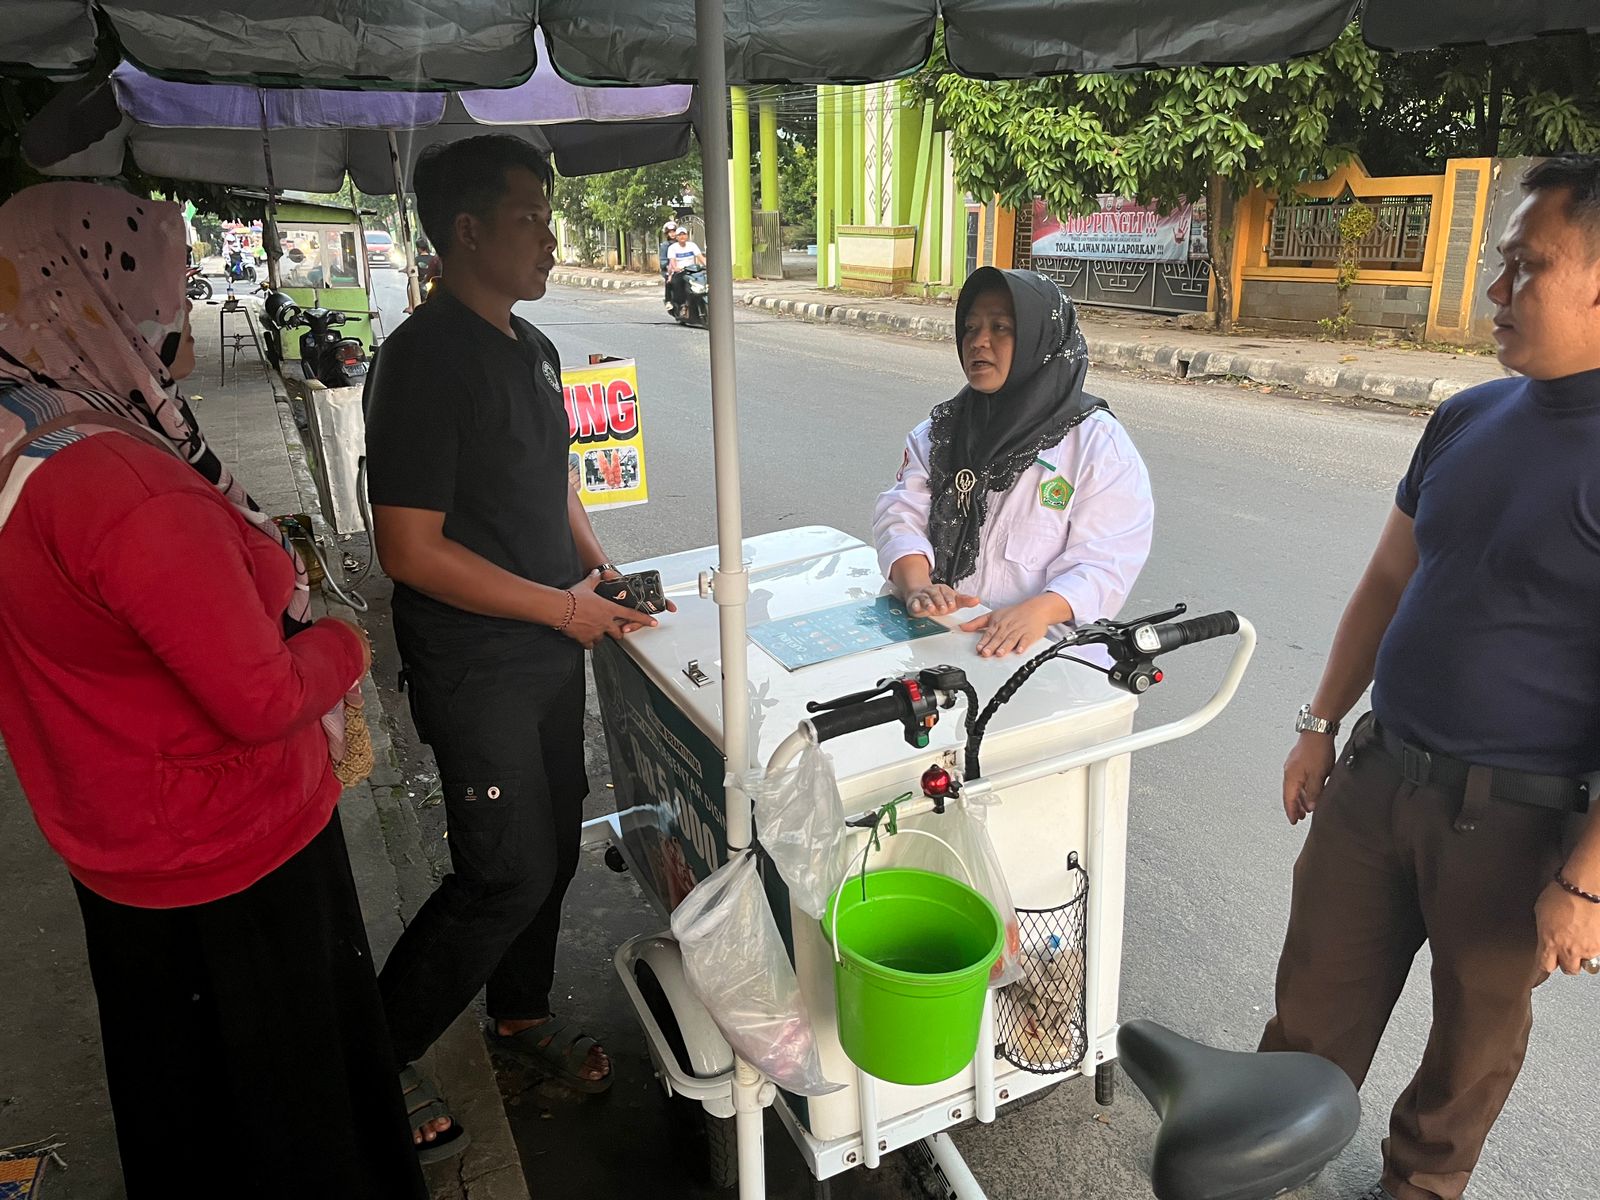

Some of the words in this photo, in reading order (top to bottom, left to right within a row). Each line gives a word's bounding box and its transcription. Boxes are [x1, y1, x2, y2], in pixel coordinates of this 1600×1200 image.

[1092, 212, 1144, 234] PUNGLI
[1056, 242, 1077, 254] TOLAK,
[1078, 243, 1101, 254] LAWAN
[1101, 244, 1116, 254] DAN
[1117, 244, 1155, 255] LAPORKAN
